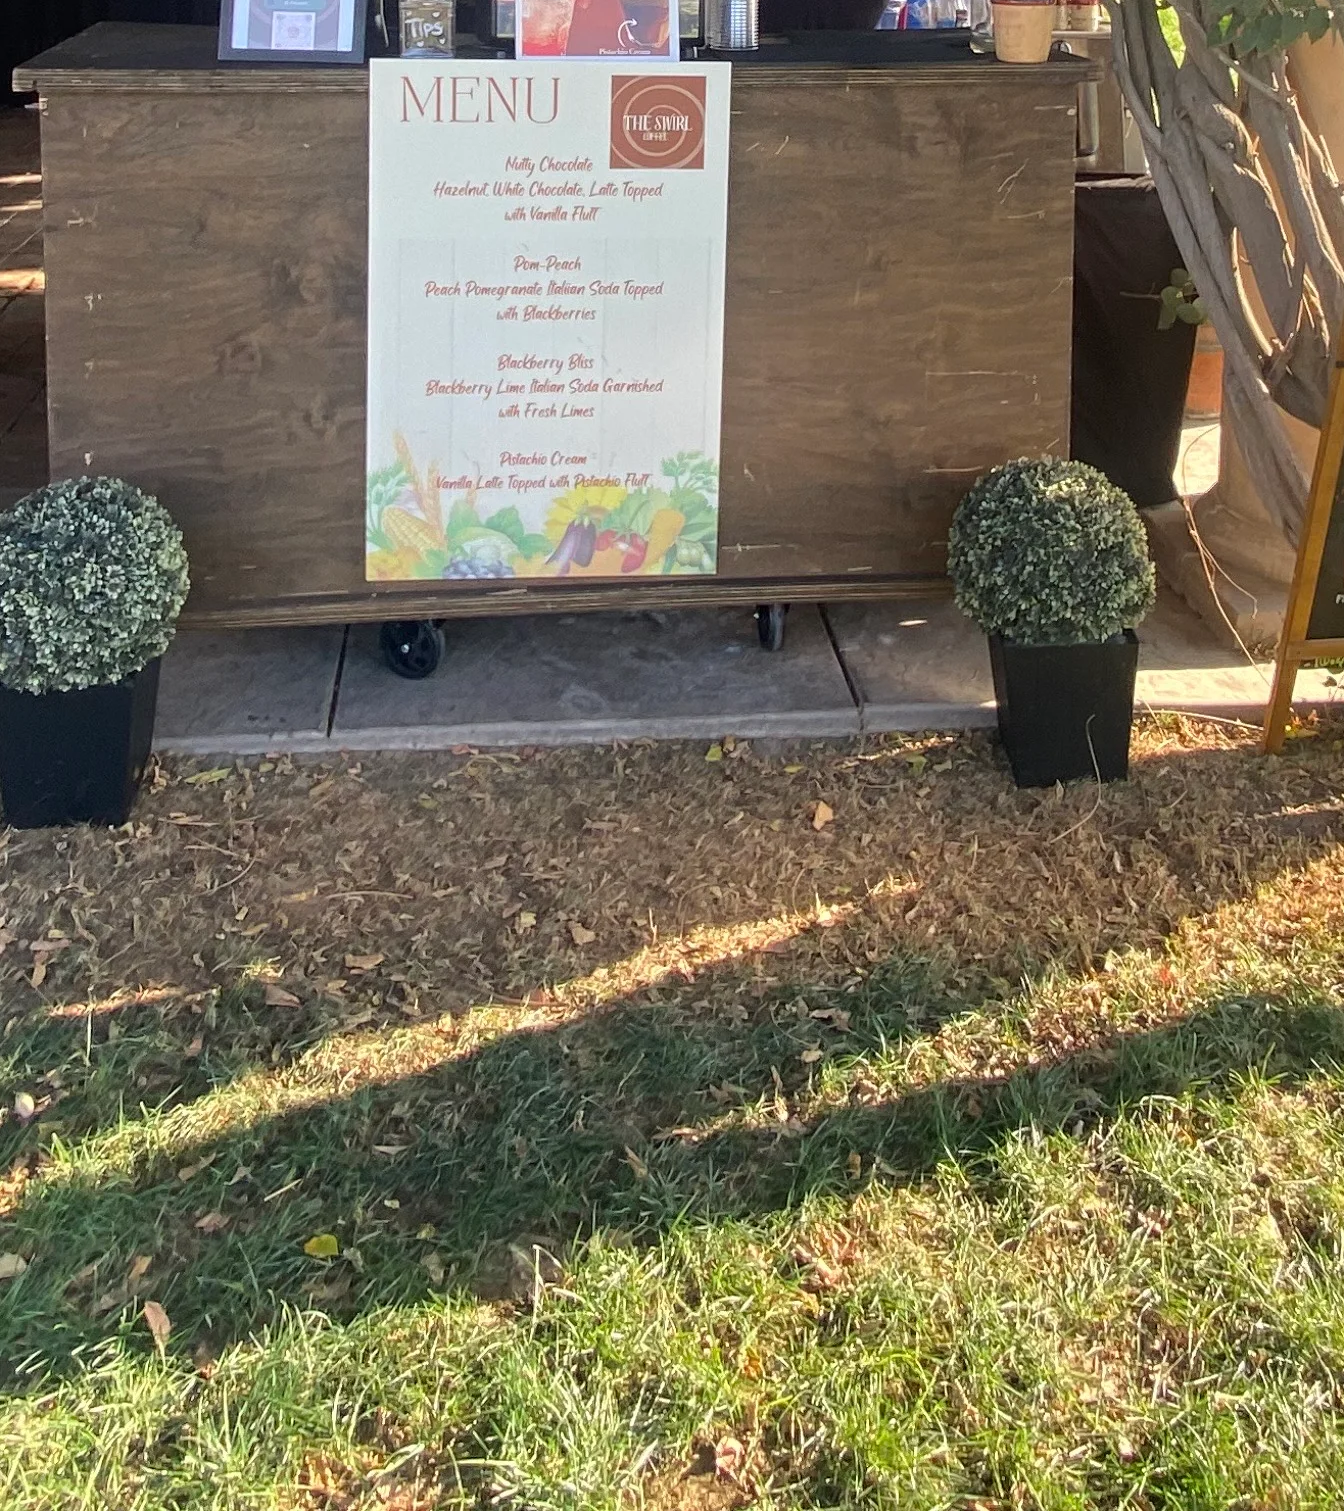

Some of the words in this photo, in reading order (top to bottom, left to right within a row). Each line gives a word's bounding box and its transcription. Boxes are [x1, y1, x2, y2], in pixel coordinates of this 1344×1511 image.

[400, 75, 561, 124] MENU
[623, 114, 653, 131] THE
[654, 112, 693, 132] SWIRL
[505, 155, 536, 178] Nutty
[539, 156, 594, 173] Chocolate
[493, 181, 525, 197] White
[589, 181, 619, 197] Latte
[622, 180, 664, 202] Topped
[504, 206, 527, 222] with
[530, 206, 568, 222] Vanilla
[513, 255, 582, 273] Pom-Peach
[425, 280, 461, 298] Peach
[465, 280, 544, 301] Pomegranate
[546, 279, 585, 297] Italian
[589, 279, 620, 297] Soda
[623, 279, 665, 301] Topped
[496, 305, 518, 321] with
[522, 304, 597, 322] Blackberries
[497, 353, 564, 376] Blackberry
[567, 353, 595, 371] Bliss
[425, 379, 493, 400] Blackberry
[496, 378, 526, 395] Lime
[528, 378, 565, 394] Italian
[568, 378, 599, 394] Soda
[602, 377, 665, 393] Garnished
[498, 404, 520, 419] with
[524, 402, 557, 419] Fresh
[560, 402, 596, 418] Limes
[499, 451, 547, 468] Pistachio
[550, 450, 588, 467] Cream
[436, 475, 473, 489] Vanilla
[476, 475, 504, 490] Latte
[507, 474, 546, 494] Topped
[549, 473, 571, 488] with
[573, 473, 621, 489] Pistachio
